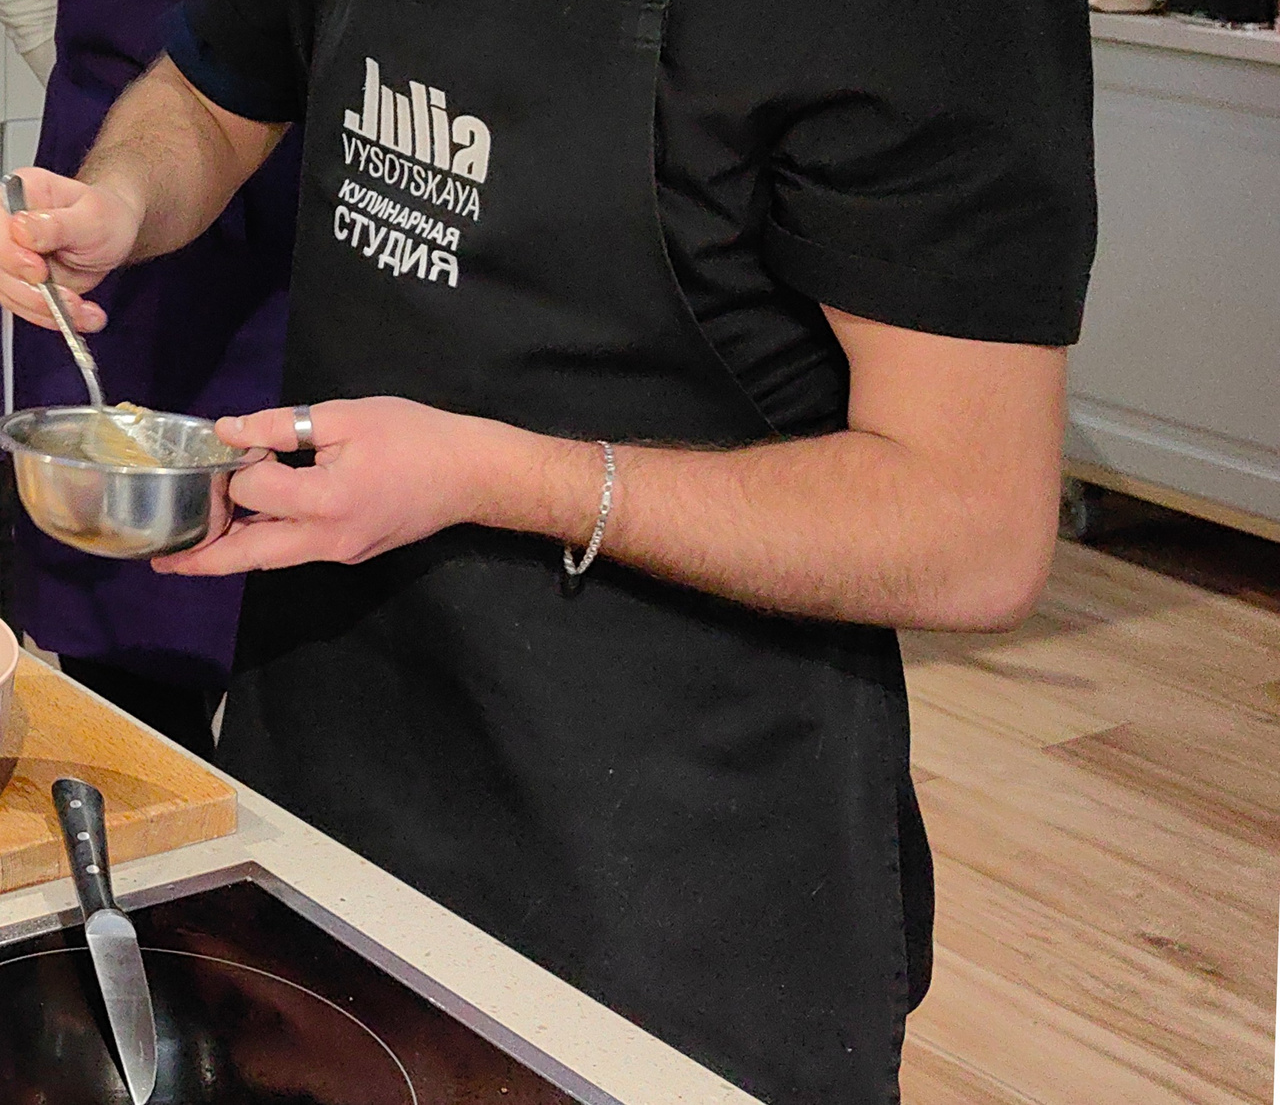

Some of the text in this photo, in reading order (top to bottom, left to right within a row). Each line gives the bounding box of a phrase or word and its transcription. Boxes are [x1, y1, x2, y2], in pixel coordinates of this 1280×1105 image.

[343, 57, 491, 184] Julia
[338, 179, 461, 251] КУЛИНАРНАЯ
[342, 132, 480, 221] VYSOTSKAYA
[333, 204, 459, 288] СТУДИЯ
